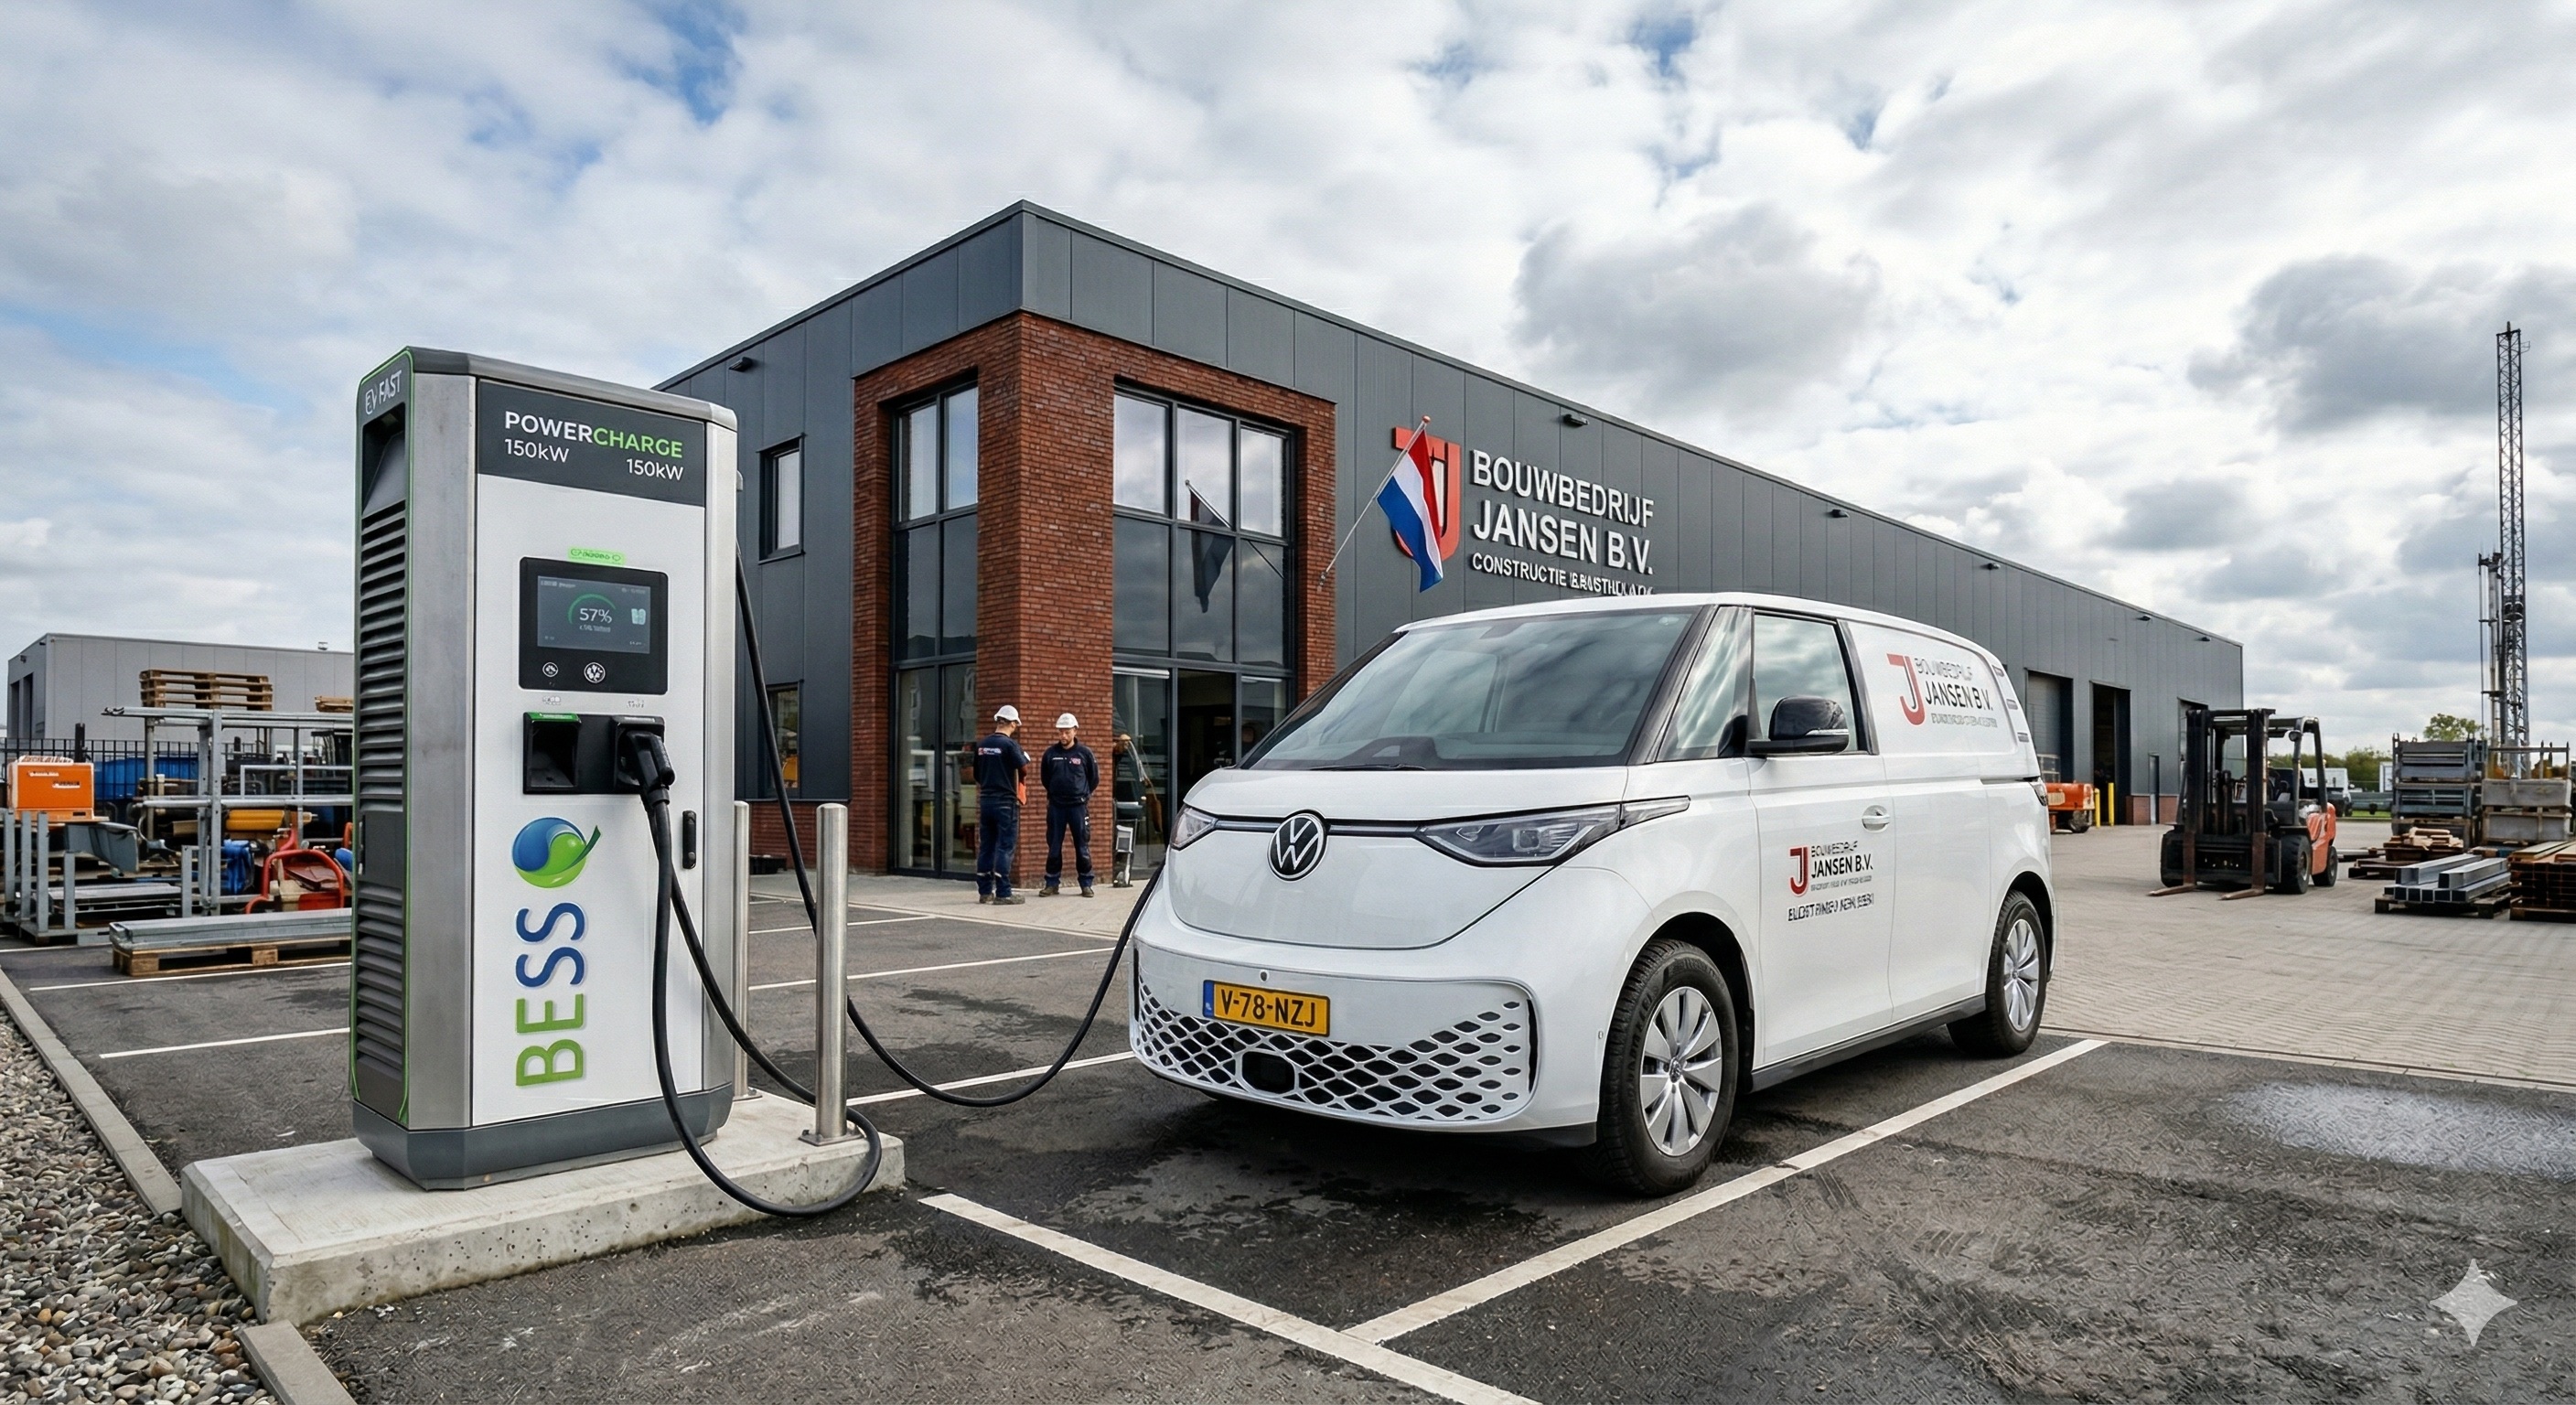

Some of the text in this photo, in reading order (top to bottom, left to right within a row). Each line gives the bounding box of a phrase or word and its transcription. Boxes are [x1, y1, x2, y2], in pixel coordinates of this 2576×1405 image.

[379, 370, 402, 405] FAST
[504, 411, 683, 458] POWERCHARGE
[504, 439, 570, 463] 150kW
[626, 458, 684, 481] 150kW
[1472, 449, 1654, 528] BOUWBEDRIJF
[1473, 499, 1654, 575] JANSEN B.V.
[1472, 552, 1567, 587] CONSTRUCTIE
[579, 607, 613, 624] 57%
[1925, 681, 1994, 712] JANSEN B.V.
[1810, 853, 1873, 879] JANSEN B.V.
[516, 902, 586, 1088] BESS
[1220, 989, 1315, 1027] V-78-NZJ
